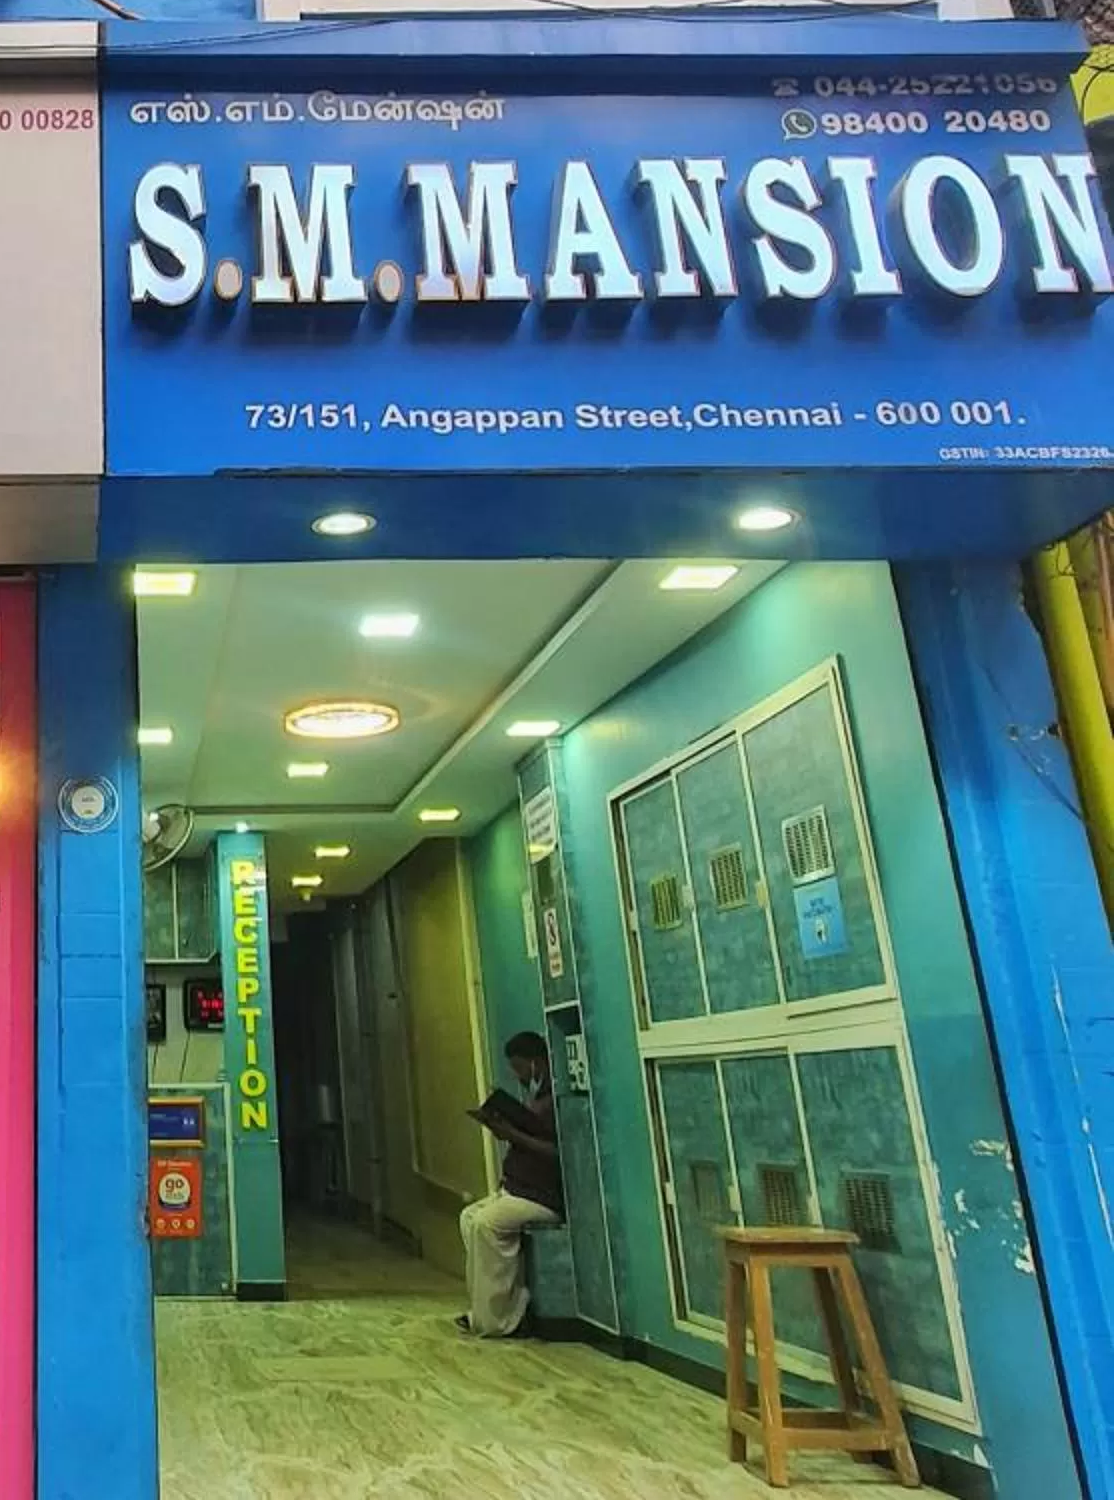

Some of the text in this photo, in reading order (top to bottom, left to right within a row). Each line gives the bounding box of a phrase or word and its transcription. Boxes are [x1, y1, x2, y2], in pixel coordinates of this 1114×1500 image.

[21, 109, 94, 131] 00828
[821, 109, 1052, 136] 98400 20480
[245, 404, 371, 432] 73/151,
[380, 404, 563, 434] Angappan
[876, 401, 942, 425] 600
[231, 860, 268, 1130] RECEPTION
